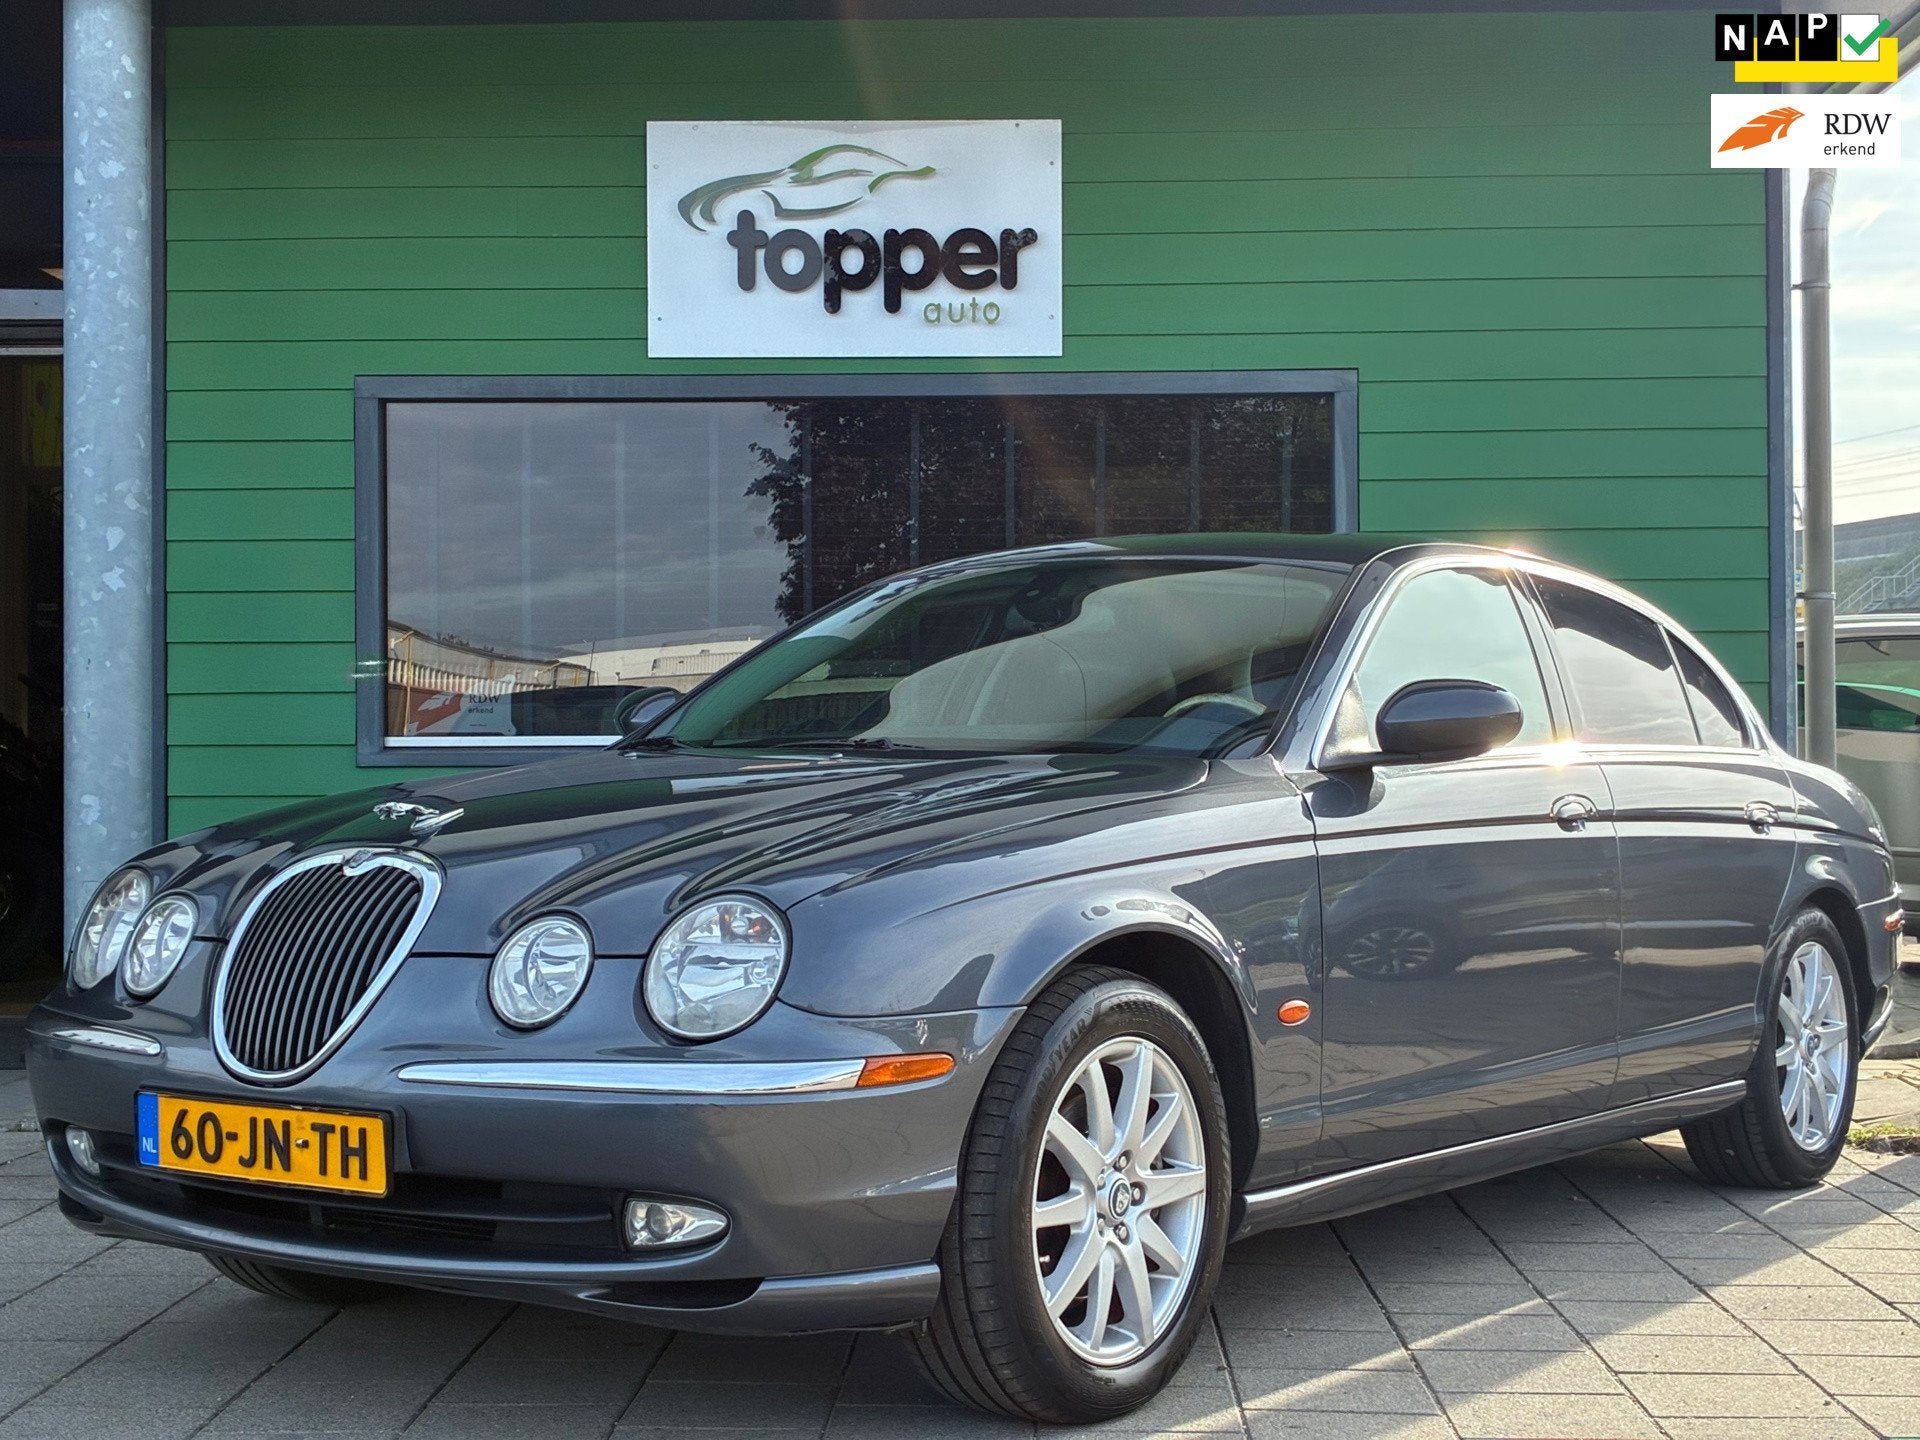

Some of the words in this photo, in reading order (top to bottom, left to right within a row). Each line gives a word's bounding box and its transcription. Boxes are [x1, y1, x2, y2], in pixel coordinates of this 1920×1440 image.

[726, 209, 1039, 315] topper
[922, 296, 1001, 325] auto
[469, 694, 500, 703] RDW
[141, 1136, 158, 1154] NL
[170, 1108, 368, 1181] 60-JN-TH
